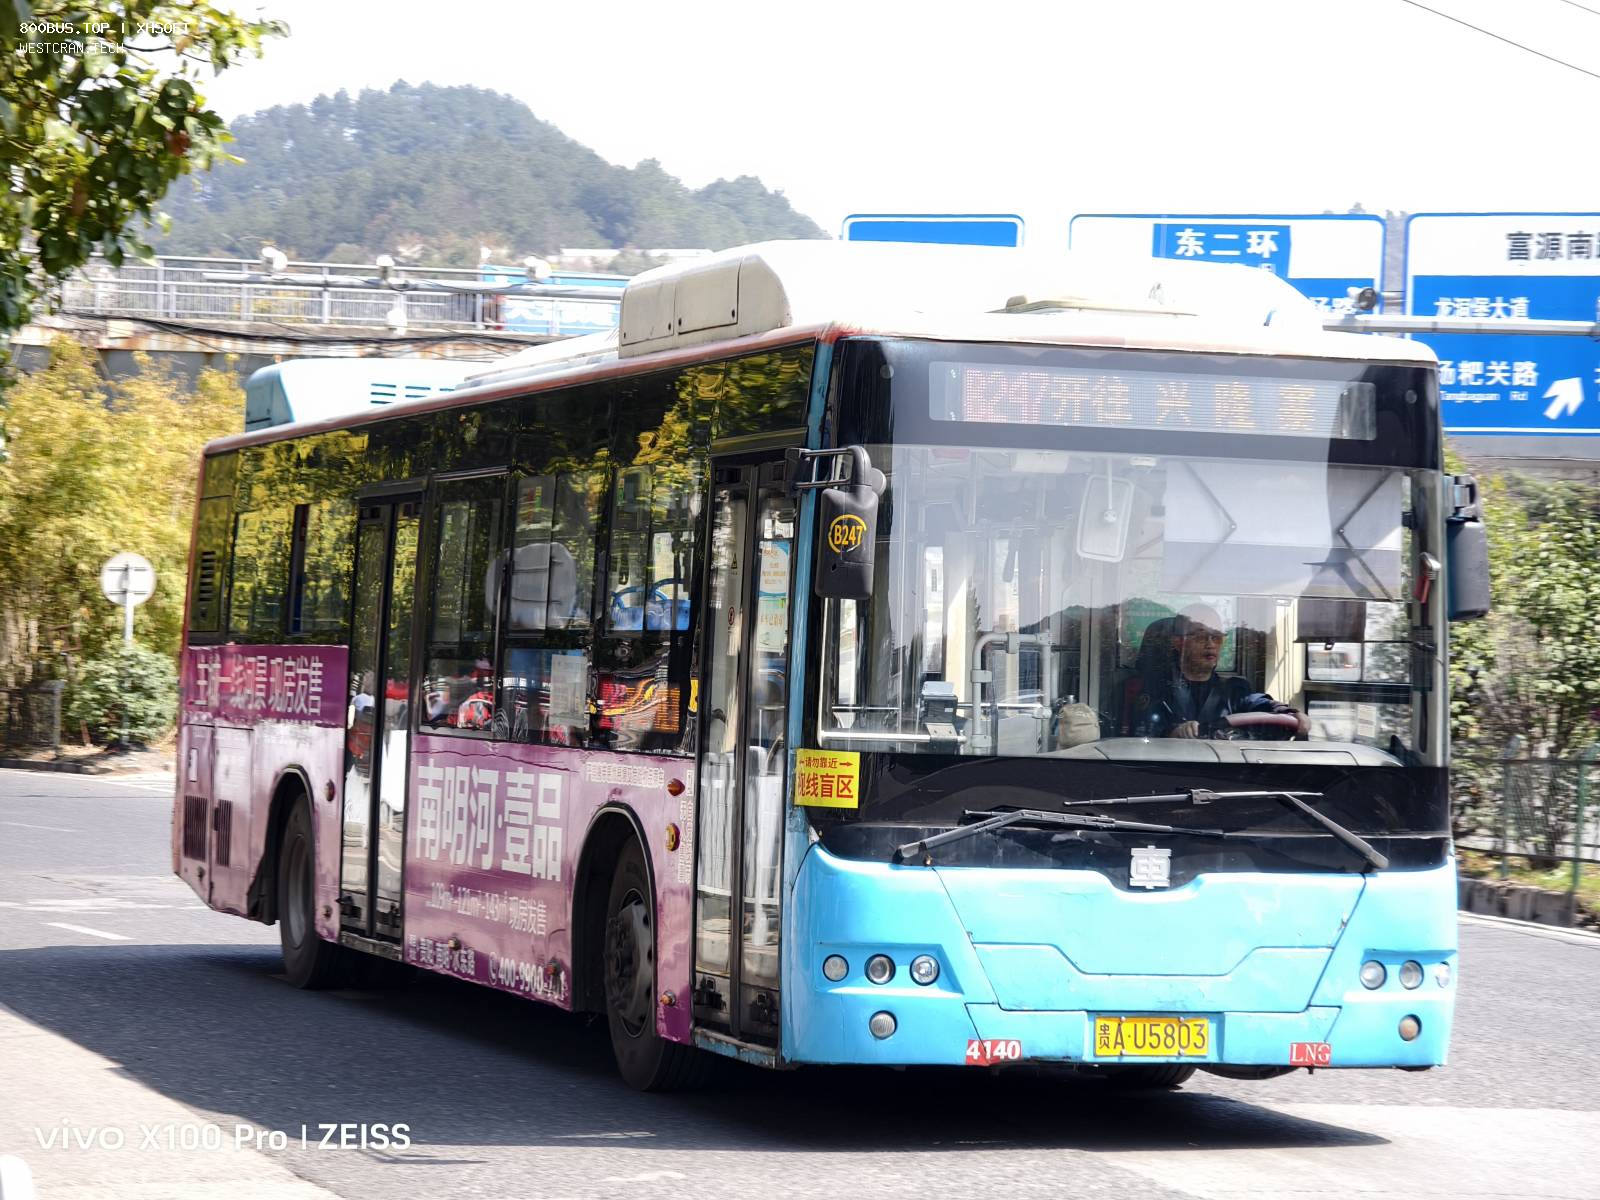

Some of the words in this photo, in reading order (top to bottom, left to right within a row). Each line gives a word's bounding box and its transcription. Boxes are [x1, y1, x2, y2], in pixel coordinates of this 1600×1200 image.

[1175, 228, 1279, 258] 东二环
[1506, 231, 1600, 260] 富源南
[834, 525, 863, 546] B247
[805, 756, 838, 768] 请勿靠近
[966, 1040, 1021, 1060] 4140
[1291, 1044, 1331, 1065] LNG
